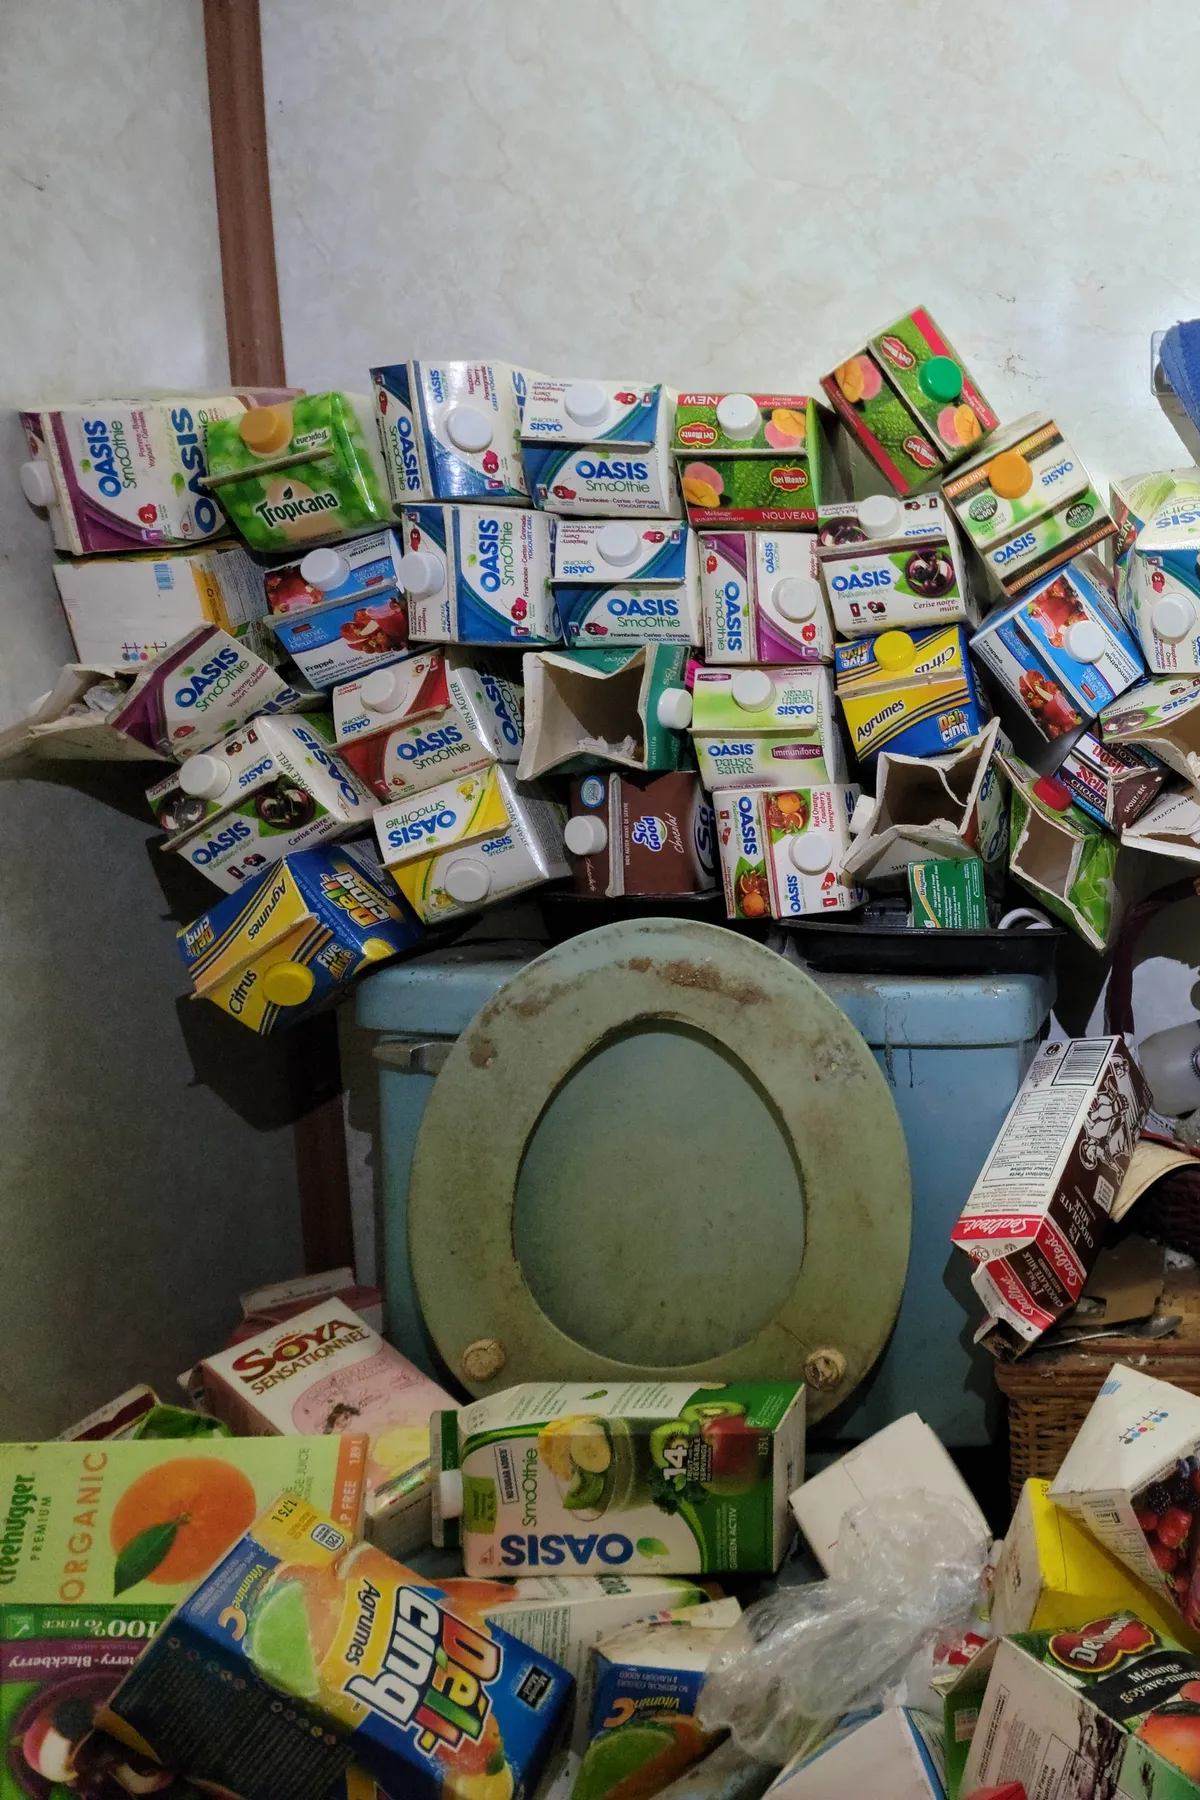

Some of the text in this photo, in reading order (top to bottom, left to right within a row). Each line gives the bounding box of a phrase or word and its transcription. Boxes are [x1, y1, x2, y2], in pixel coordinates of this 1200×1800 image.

[433, 370, 443, 403] OASIS
[683, 396, 718, 405] NEW
[295, 428, 328, 446] Tropicana
[530, 423, 563, 432] OASIS
[84, 419, 122, 498] OASIS
[397, 417, 421, 491] OASIS
[576, 460, 648, 479] OASIS
[171, 408, 216, 533] OASIS
[785, 476, 806, 484] Monte
[1041, 461, 1074, 486] OASIS
[256, 491, 339, 529] Tropicana
[762, 512, 815, 520] NOUVEAU
[992, 532, 1037, 564] OASIS
[1115, 520, 1133, 556] NEW!
[479, 519, 501, 592] OASIS
[563, 565, 594, 575] OASIS
[764, 541, 774, 573] OASIS
[831, 569, 891, 591] OASIS
[607, 598, 679, 616] OASIS
[724, 581, 742, 652] OASIS
[305, 659, 334, 672] Frappé
[843, 650, 869, 668] Five
[914, 645, 956, 674] Citrus
[174, 648, 239, 708] OASIS
[479, 661, 518, 746] OASIS
[777, 706, 814, 715] OASIS
[342, 718, 371, 735] OASIS
[856, 699, 905, 742] Agrumes
[941, 724, 970, 743] cinq
[397, 724, 463, 761] OASIS
[708, 743, 753, 756] OASIS
[773, 747, 821, 757] Immuniforce
[239, 759, 273, 786] OASIS
[293, 727, 359, 806] OASIS
[715, 757, 752, 768] pause
[717, 764, 754, 775] santé
[820, 791, 828, 823] Cranberry,
[1124, 784, 1147, 813] SPOUT/BEC
[388, 810, 457, 848] OASIS
[647, 815, 662, 851] Good
[666, 813, 685, 853] chocolat
[738, 796, 757, 855] OASIS
[191, 821, 251, 865] OASIS
[481, 835, 513, 852] OASIS
[249, 878, 286, 940] Agrumes
[334, 872, 391, 923] cinq
[358, 880, 391, 907] Agrumes
[790, 874, 800, 913] OASIS
[185, 919, 210, 946] cinq
[316, 943, 341, 970] Five
[328, 949, 356, 980] Alive
[229, 970, 257, 1015] Citrus
[963, 1219, 1026, 1234] Sealtest
[1061, 1192, 1094, 1248] CHOCOLATE
[1074, 1199, 1090, 1224] MILK
[1045, 1233, 1077, 1286] Sealtest
[1002, 1275, 1034, 1316] Sealtest
[232, 1319, 361, 1384] SOYA
[251, 1328, 370, 1395] SENSATIONNEL
[663, 1443, 689, 1481] 14
[700, 1444, 708, 1481] SERVINGS
[342, 1480, 356, 1510] FREE
[30, 1496, 52, 1561] PREMIUM
[60, 1452, 108, 1602] ORGANIC
[728, 1507, 738, 1569] GREEN ACTIV
[500, 1533, 634, 1566] OASIS
[218, 1563, 267, 1642] Vitamine C
[345, 1578, 381, 1666] Agrumes
[8, 1653, 91, 1669] Blackberry
[344, 1587, 440, 1725] cinq
[1069, 1638, 1104, 1664] Del
[1128, 1662, 1183, 1683] Mélange
